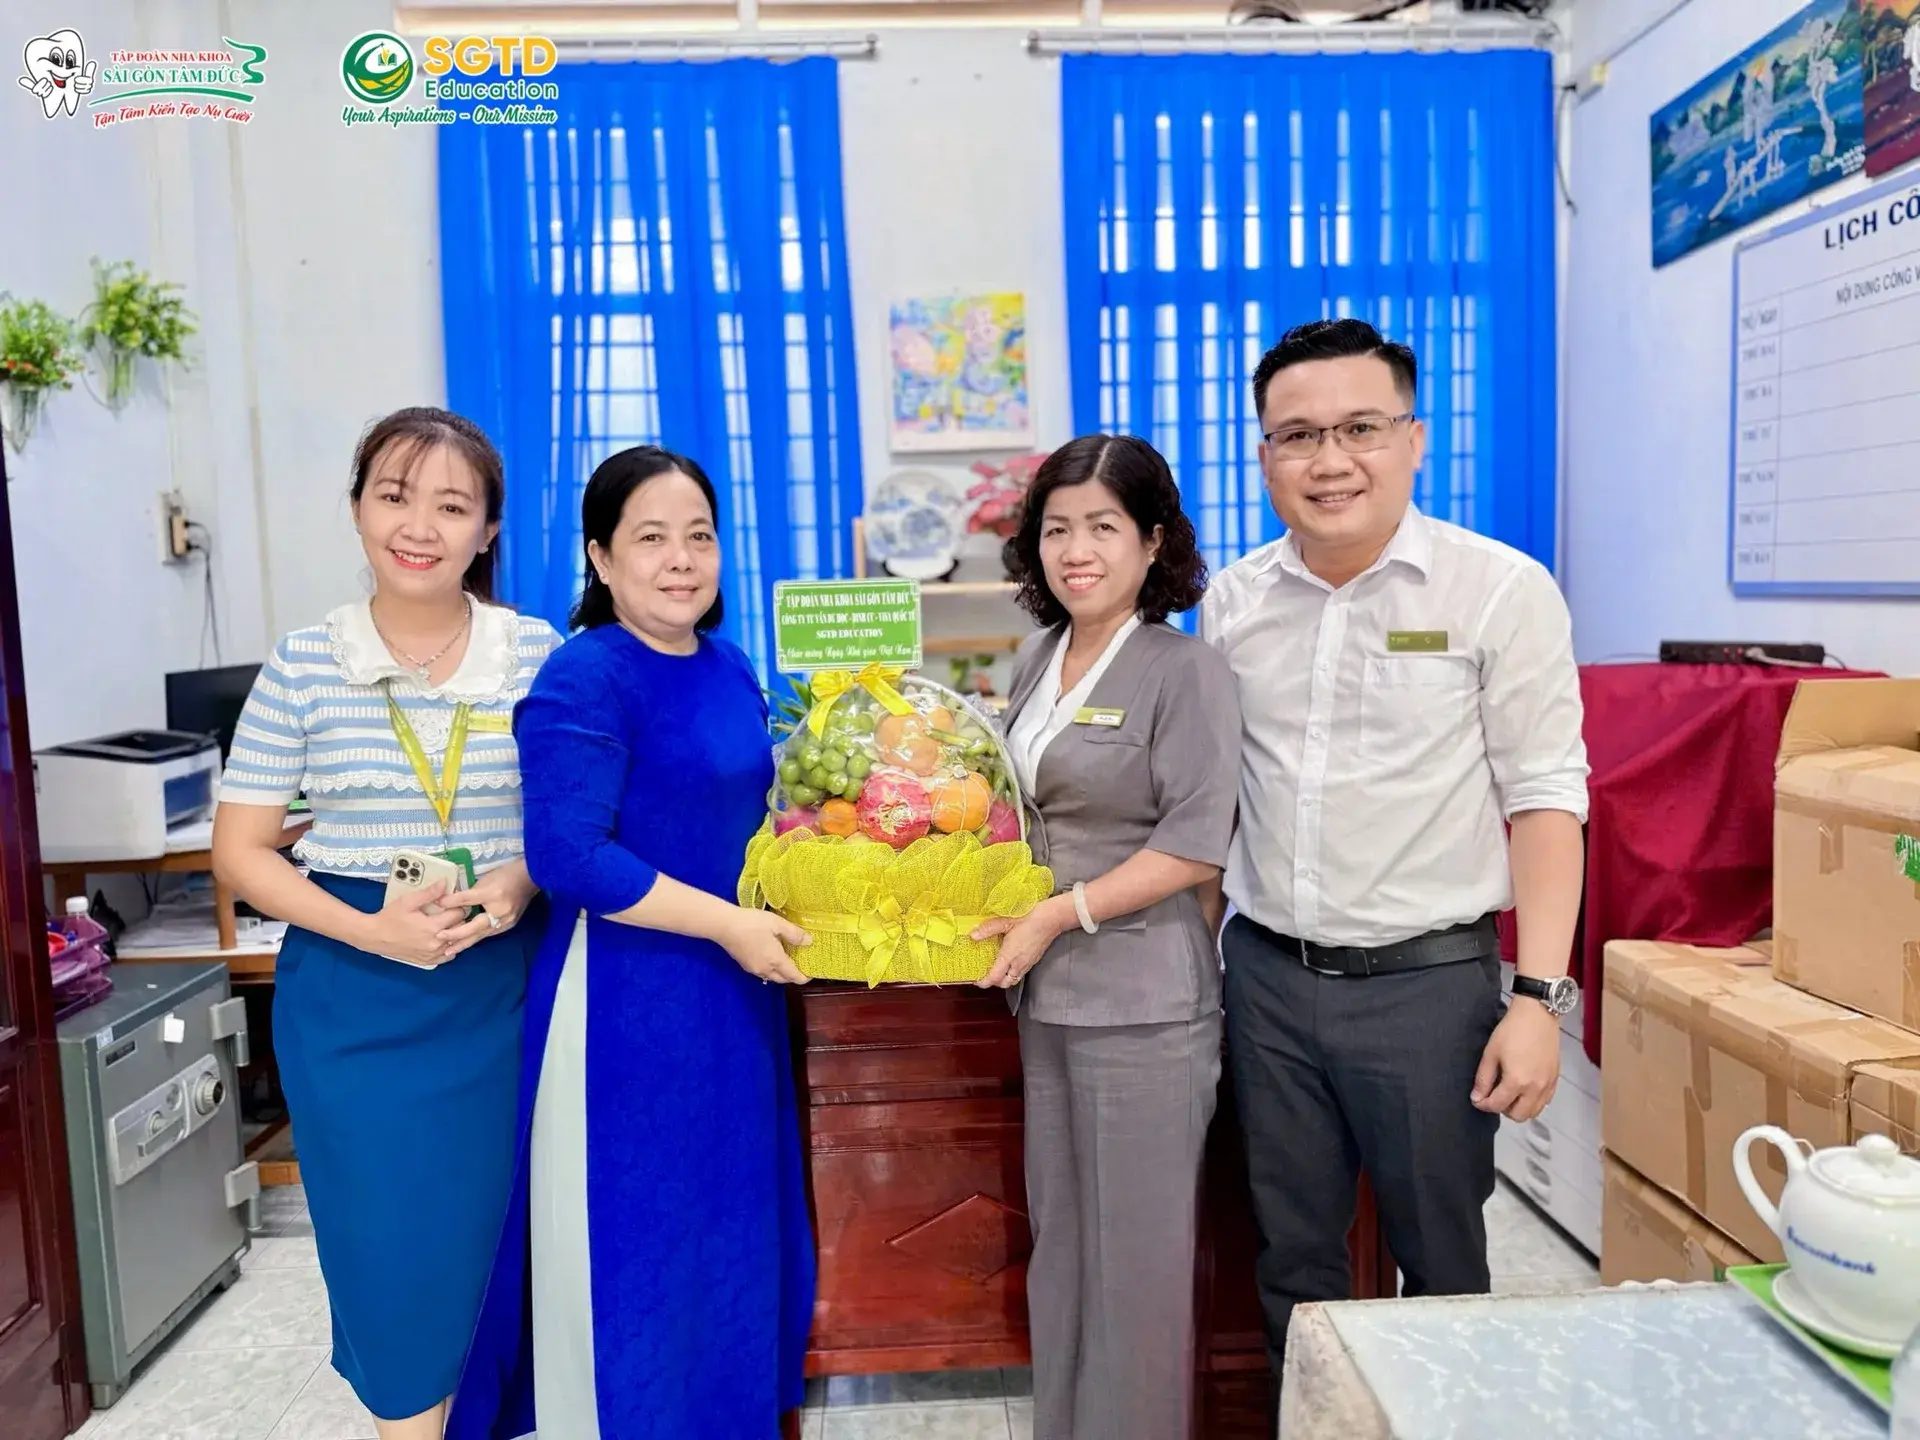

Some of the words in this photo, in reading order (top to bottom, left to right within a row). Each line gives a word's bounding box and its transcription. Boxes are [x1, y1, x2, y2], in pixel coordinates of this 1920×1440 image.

[1825, 209, 1878, 250] LỊCH
[1854, 276, 1881, 299] DUNG
[838, 628, 883, 638] EDUCATION
